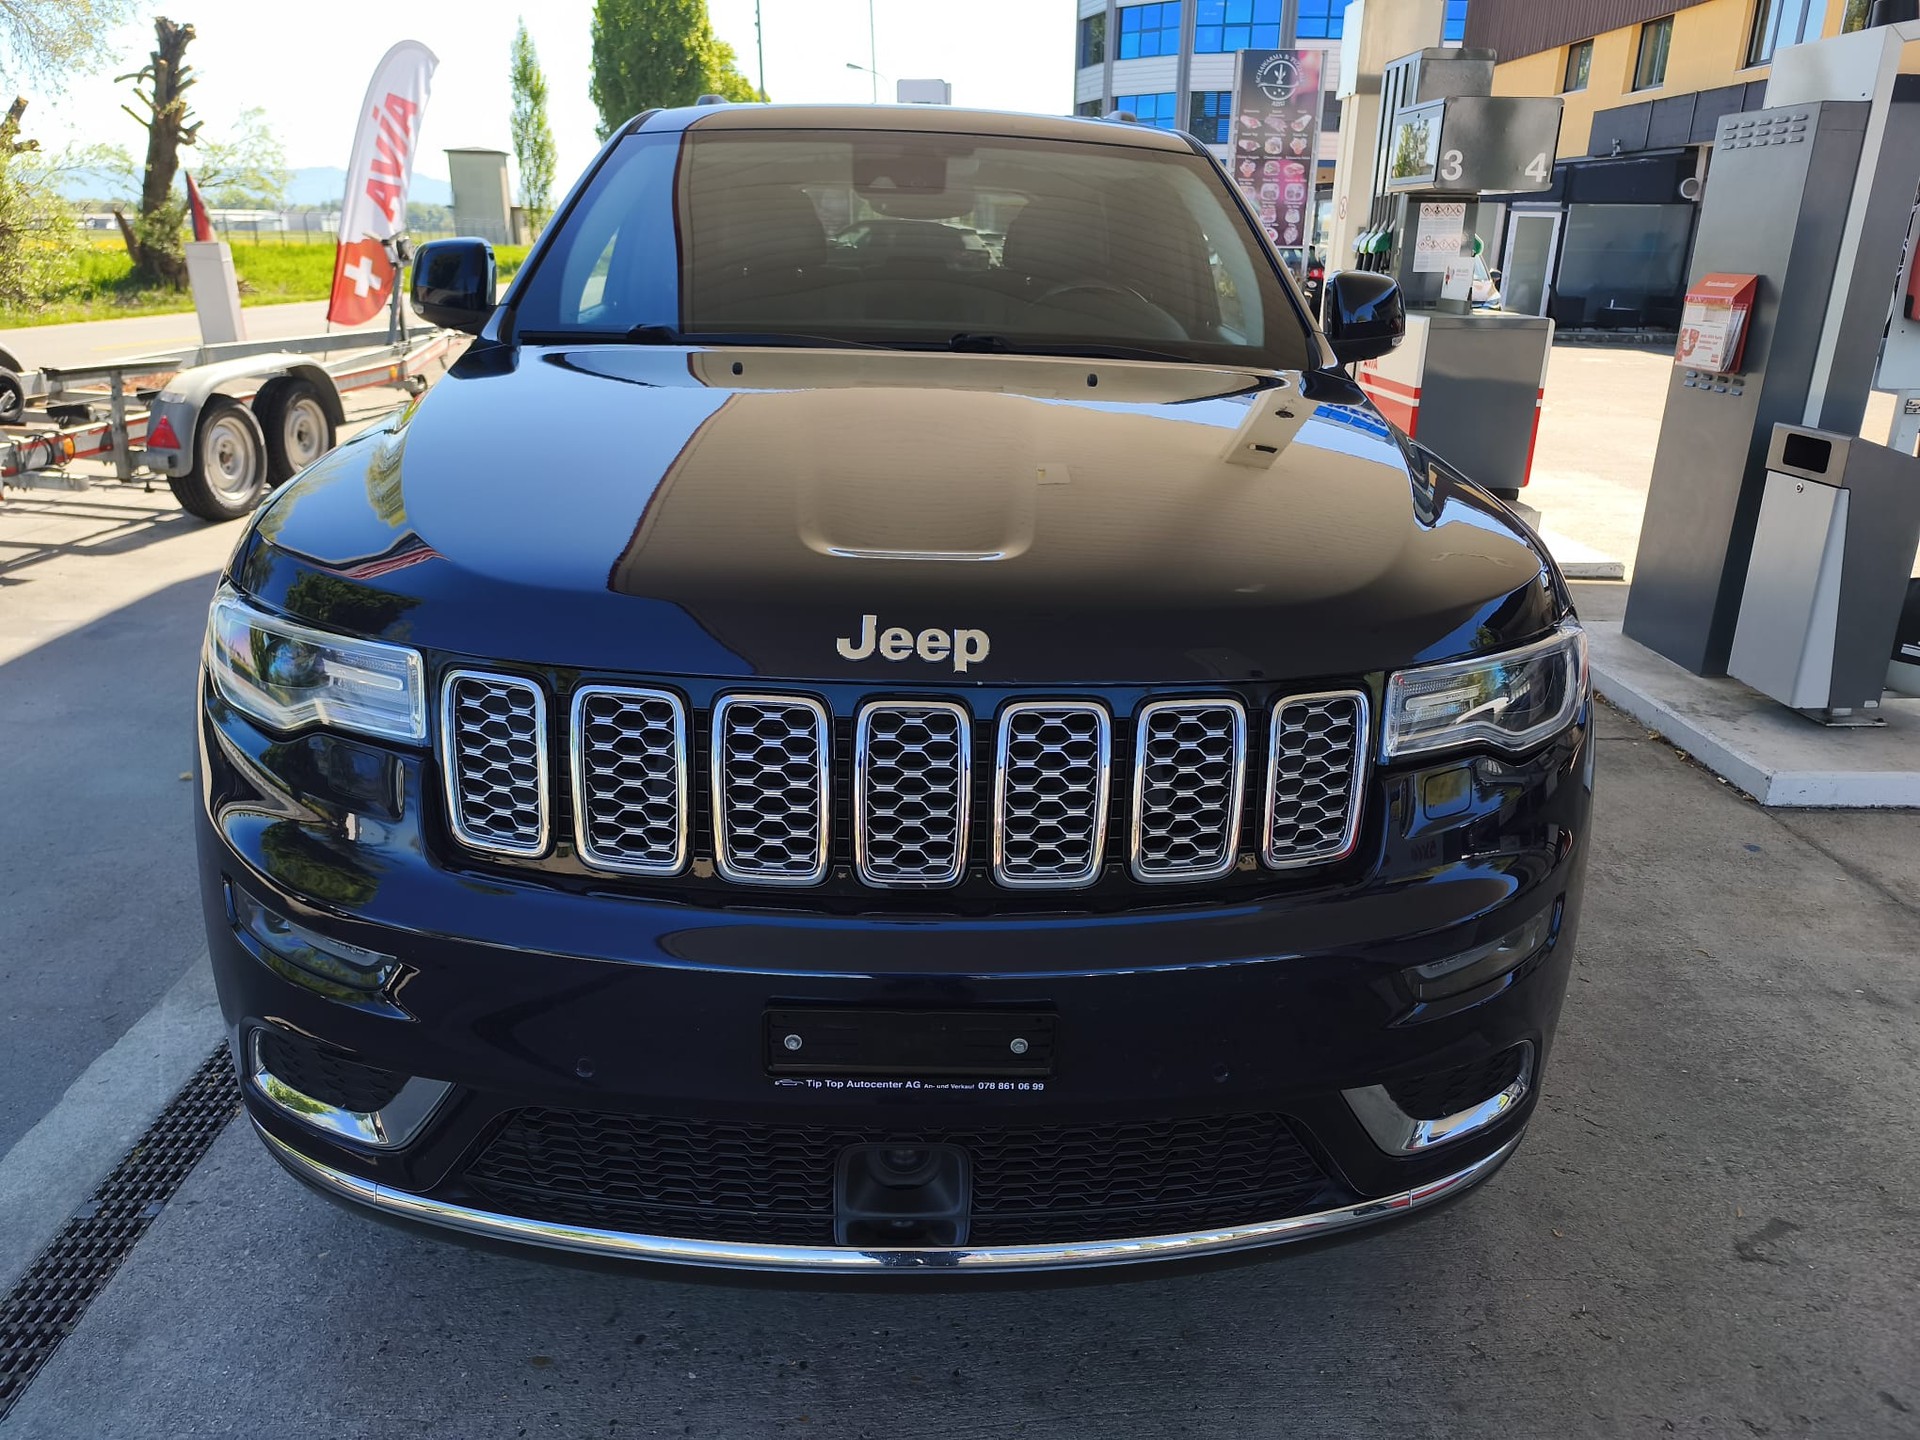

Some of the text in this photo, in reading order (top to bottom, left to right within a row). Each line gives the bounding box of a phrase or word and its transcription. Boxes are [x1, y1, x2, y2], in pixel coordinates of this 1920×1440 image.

[365, 92, 418, 223] AVIA
[1441, 150, 1464, 181] 3
[1524, 153, 1548, 182] 4
[836, 614, 991, 673] Jeep
[805, 1079, 823, 1089] Tip
[824, 1079, 845, 1090] Top
[846, 1080, 903, 1089] Autocenter
[904, 1080, 921, 1089] AG
[978, 1081, 996, 1090] 078
[998, 1082, 1015, 1090] 861
[1018, 1082, 1030, 1090] 06
[1032, 1082, 1045, 1091] 99
